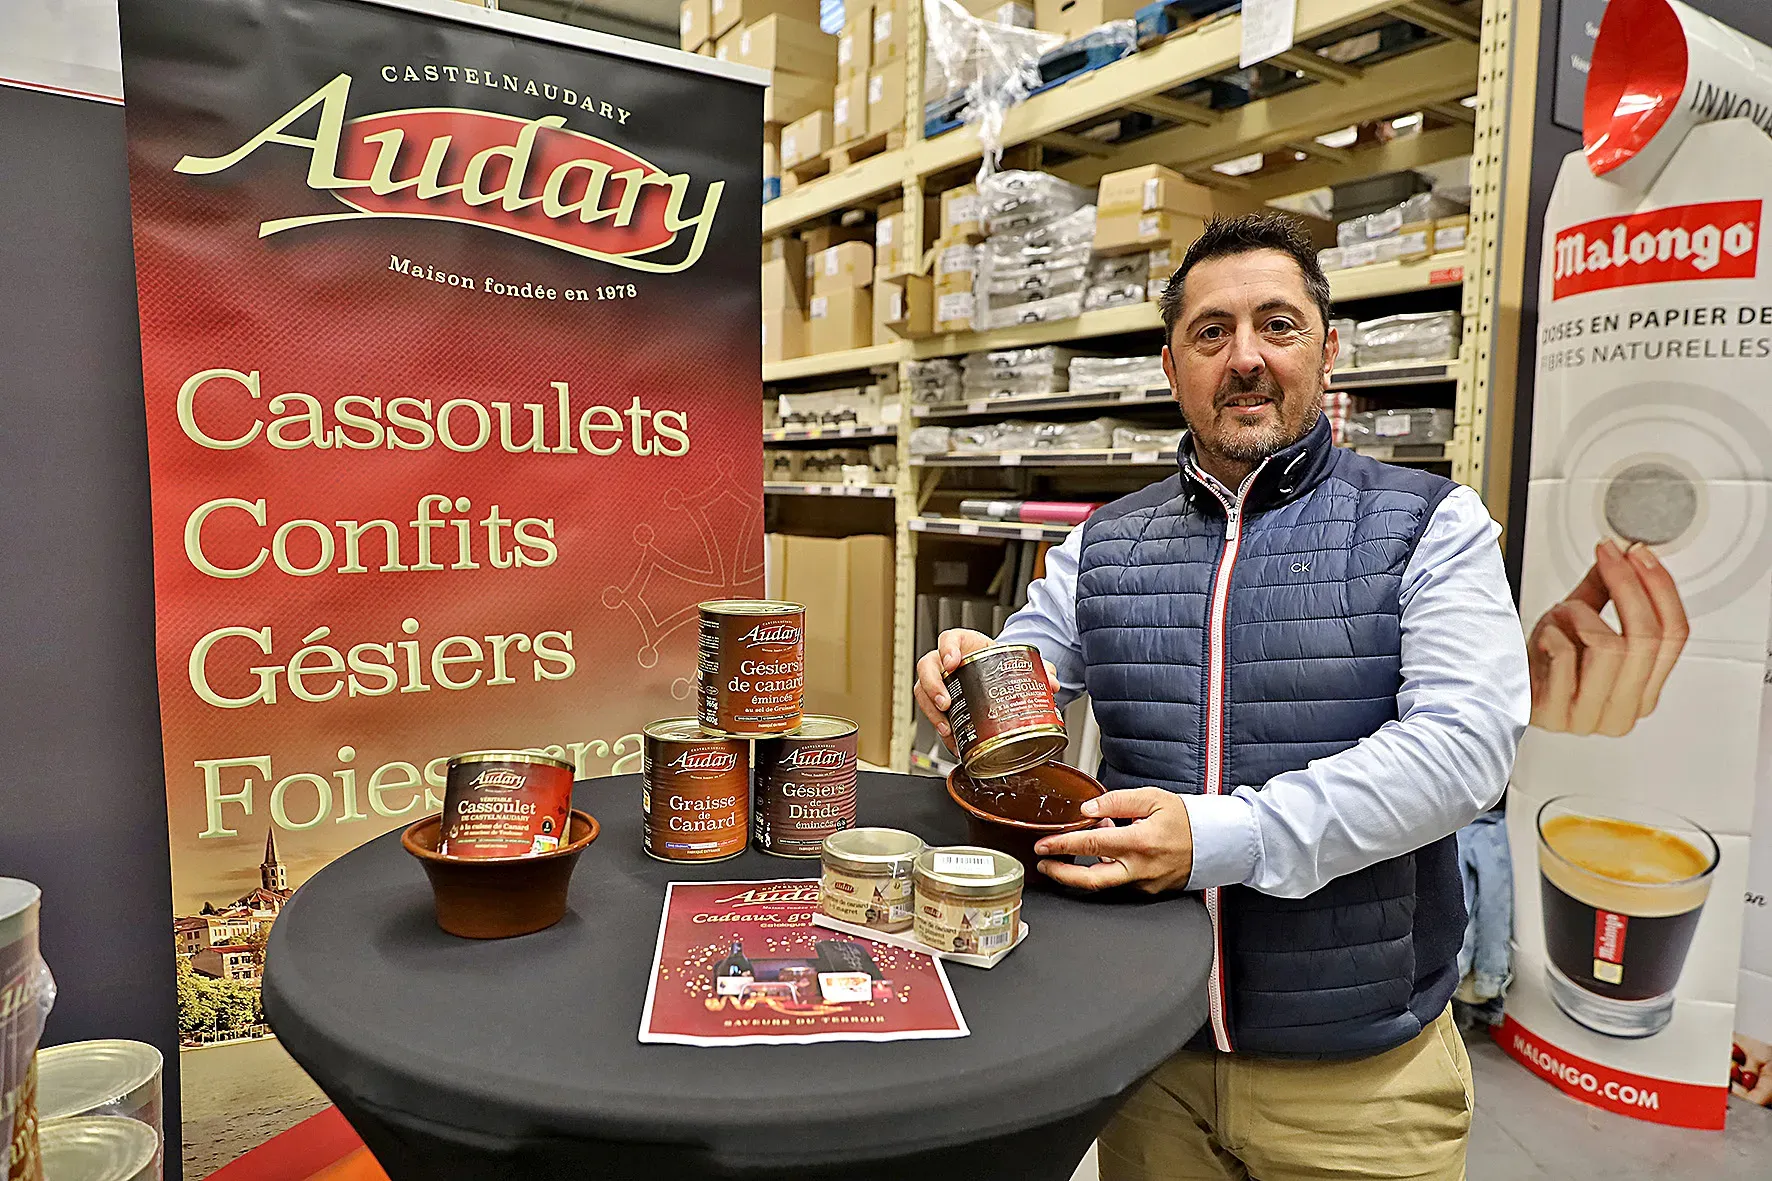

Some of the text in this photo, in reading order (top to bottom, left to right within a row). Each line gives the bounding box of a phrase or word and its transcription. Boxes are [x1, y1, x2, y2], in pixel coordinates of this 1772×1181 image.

[381, 65, 632, 126] CASTELNAUDARY
[173, 73, 725, 273] Audary
[1555, 221, 1752, 279] Malongo
[388, 254, 638, 301] Maison fondée en 1978
[1590, 315, 1620, 334] EN
[1628, 307, 1726, 329] PAPIER
[1738, 306, 1772, 325] DE
[1592, 338, 1771, 364] NATURELLES
[176, 368, 690, 457] Cassoulets
[184, 494, 559, 579] Confits
[738, 624, 800, 648] Audary
[188, 617, 576, 708] Gésiers
[740, 660, 799, 676] Gésiers
[728, 677, 750, 692] de
[988, 680, 1048, 699] Cassoulet
[751, 694, 793, 704] émincés
[667, 751, 738, 775] Audary
[779, 749, 847, 772] Audary
[469, 770, 527, 790] Audary
[782, 782, 845, 798] Gésiers
[457, 800, 536, 814] Cassoulet
[669, 795, 736, 811] Graisse
[789, 804, 840, 819] Dinde
[809, 799, 822, 807] de
[669, 812, 736, 832] Canard
[698, 811, 711, 820] de
[796, 820, 834, 830] émincés
[692, 912, 782, 924] Cadeaux
[1513, 1035, 1659, 1110] MALONGO.COM
